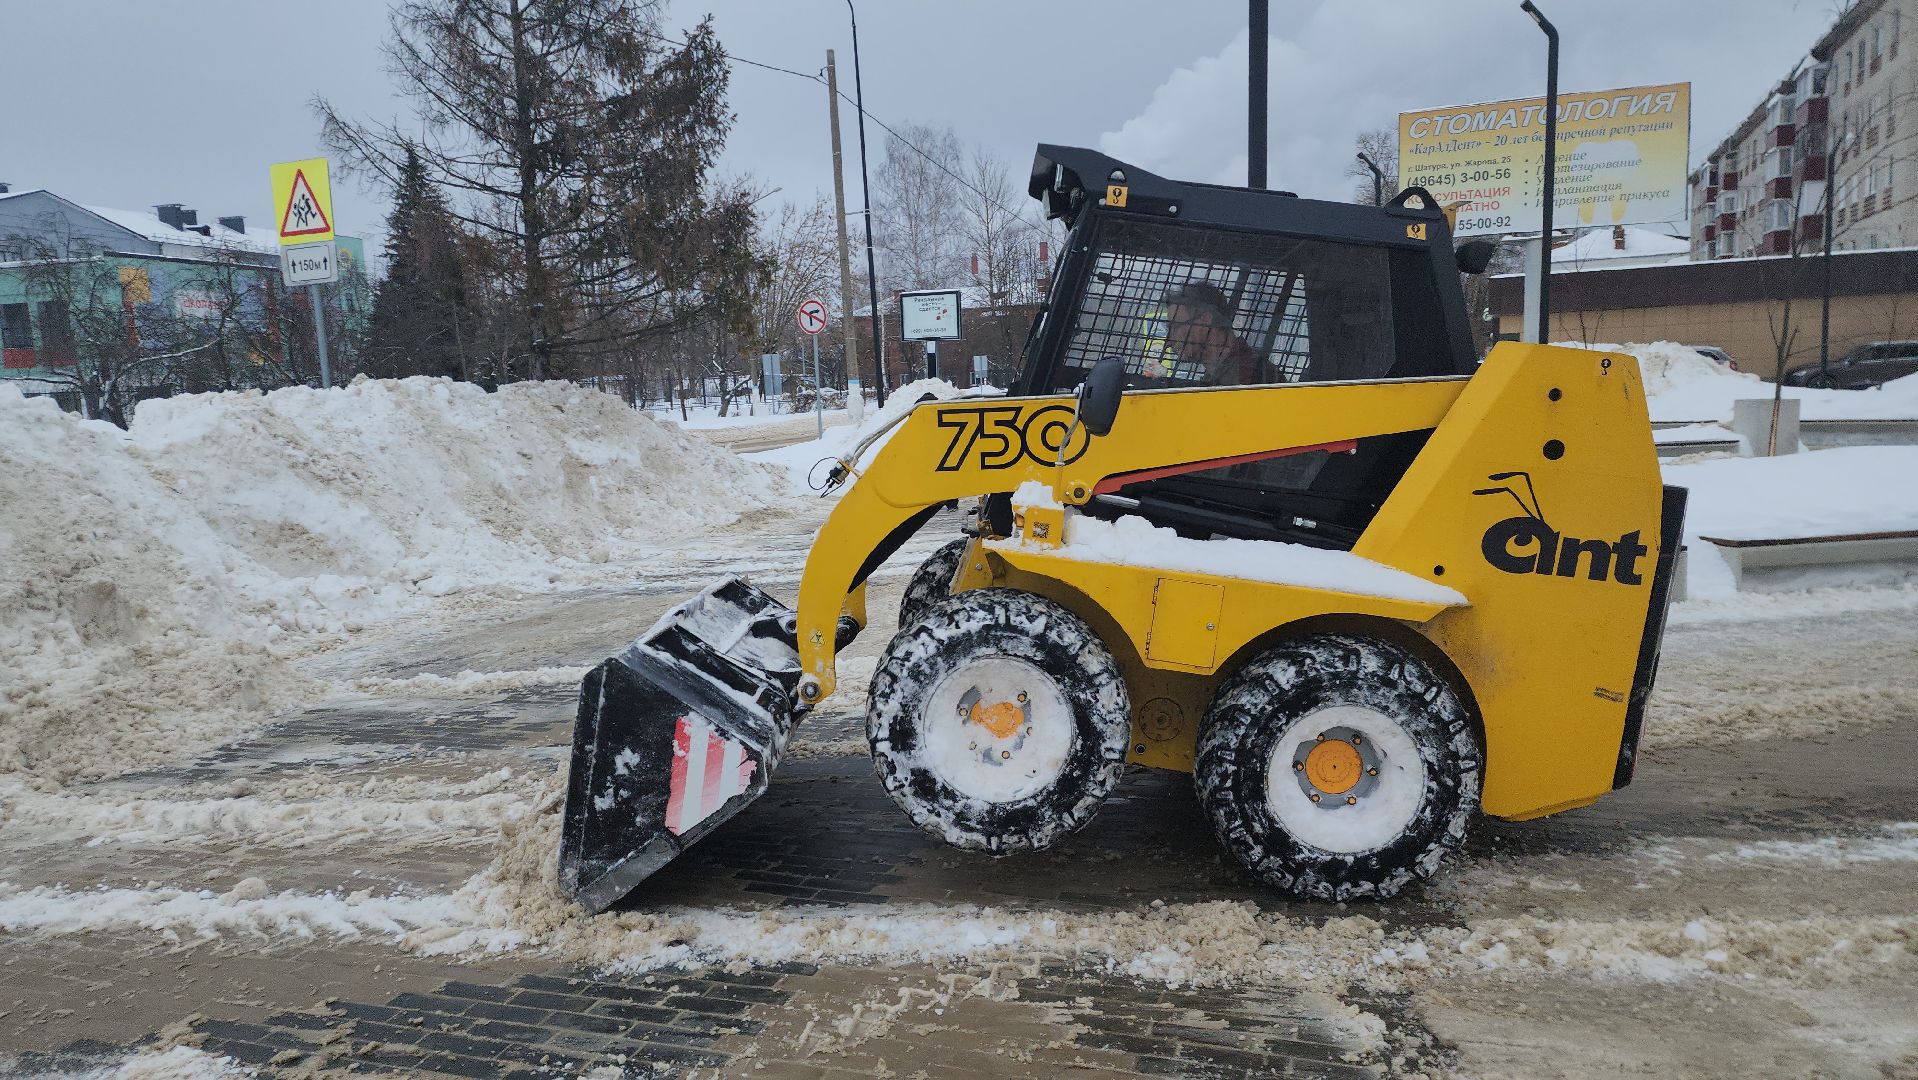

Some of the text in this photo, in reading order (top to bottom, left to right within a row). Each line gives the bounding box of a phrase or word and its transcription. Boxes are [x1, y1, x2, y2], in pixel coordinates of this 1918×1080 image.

[1408, 91, 1678, 139] СТОМАТОЛОГИЯ
[1493, 134, 1508, 147] 20
[1407, 168, 1512, 188] (49645) 3-00-56
[935, 404, 1091, 472] 750
